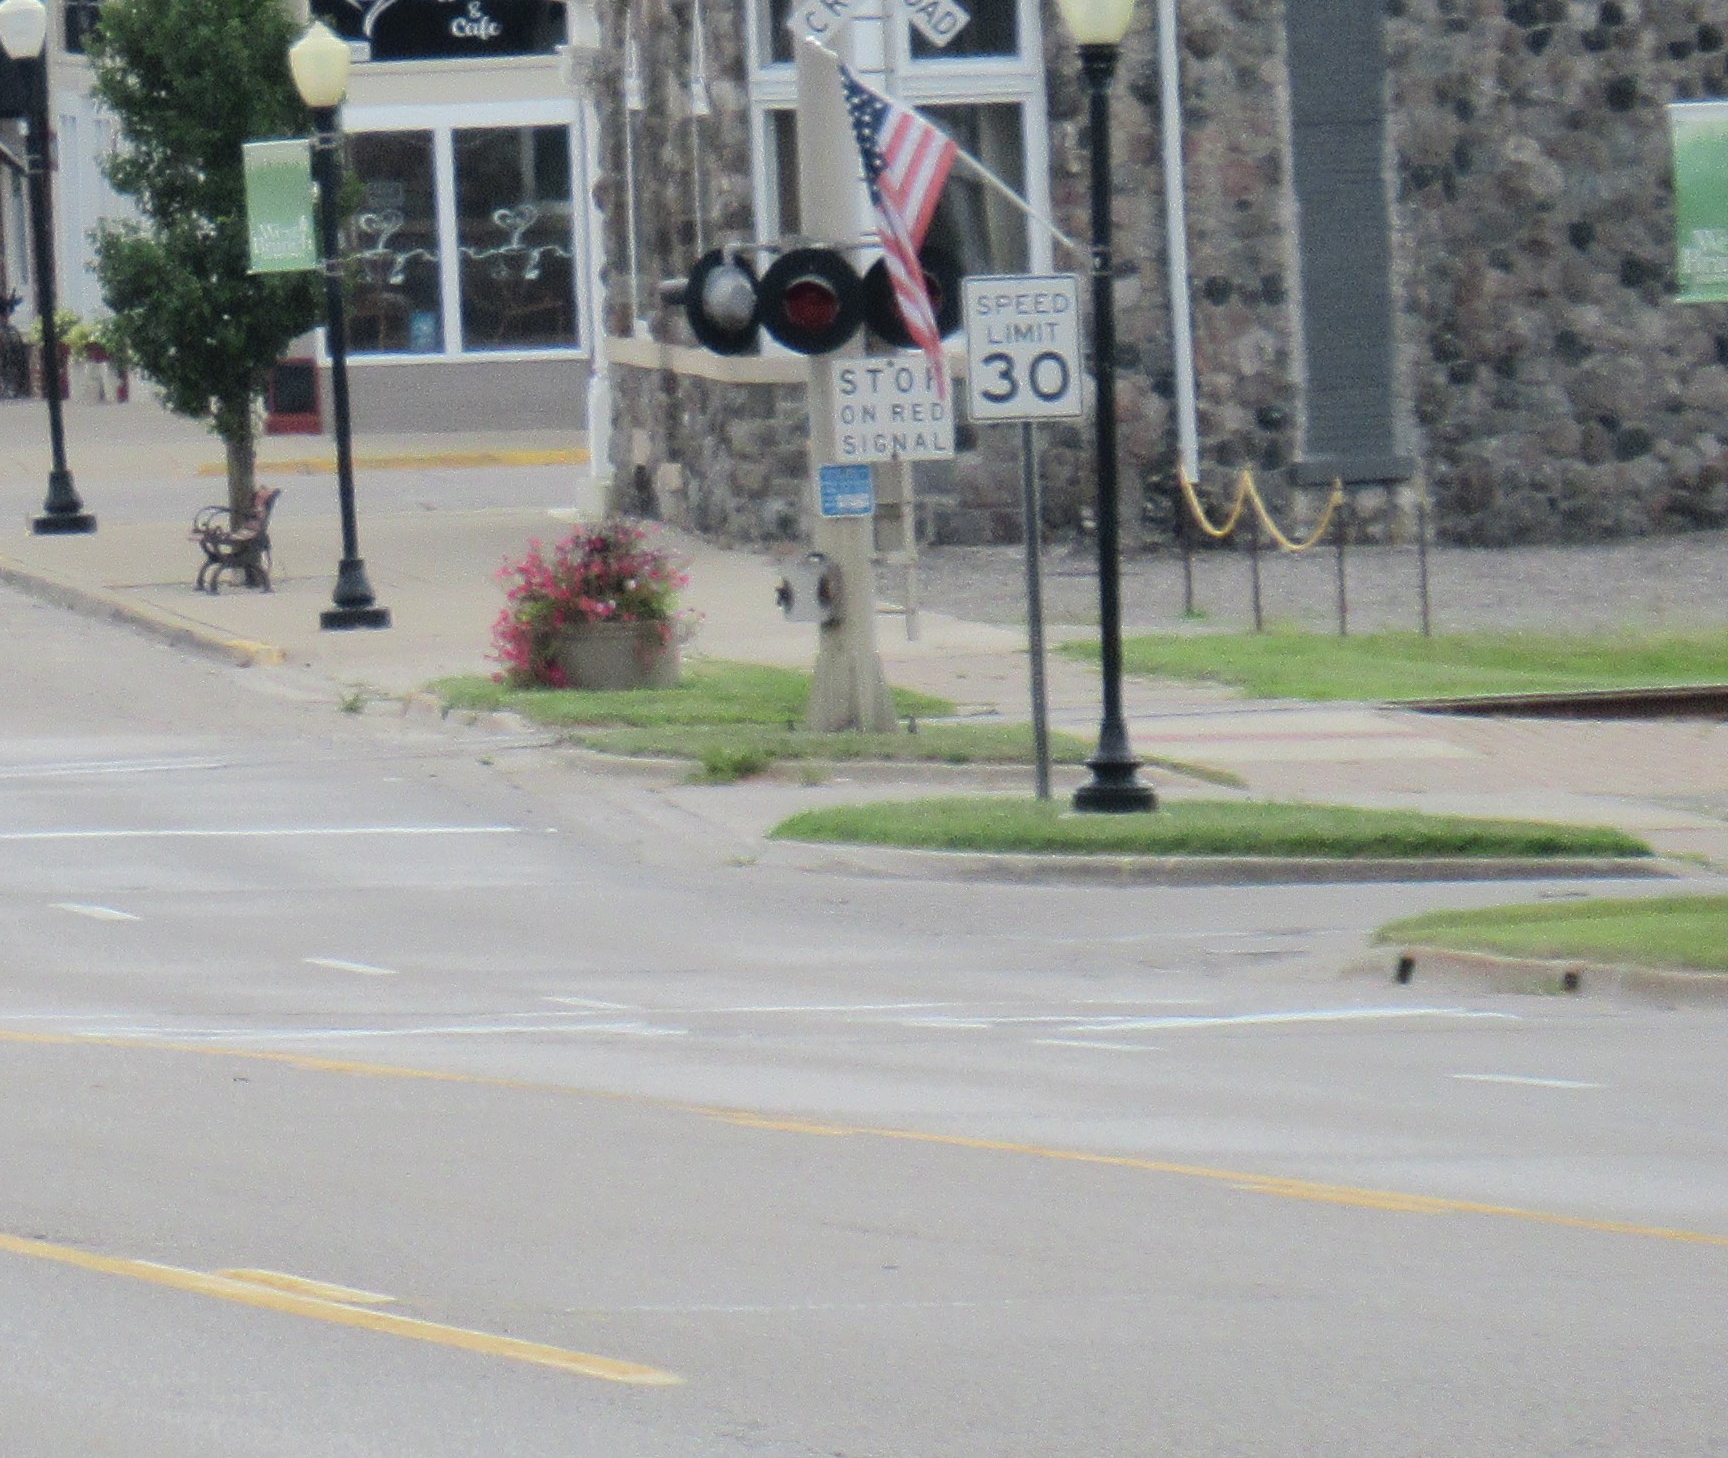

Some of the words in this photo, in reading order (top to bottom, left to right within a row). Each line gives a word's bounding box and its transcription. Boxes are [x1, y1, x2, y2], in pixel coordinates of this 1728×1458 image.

[467, 1, 482, 19] &
[451, 17, 502, 41] Cafe
[976, 292, 1069, 316] SPEED
[986, 321, 1060, 345] LIMIT
[981, 350, 1071, 404] 30
[841, 404, 876, 425] ON
[891, 402, 944, 423] RED
[842, 432, 946, 454] SIGNAL
